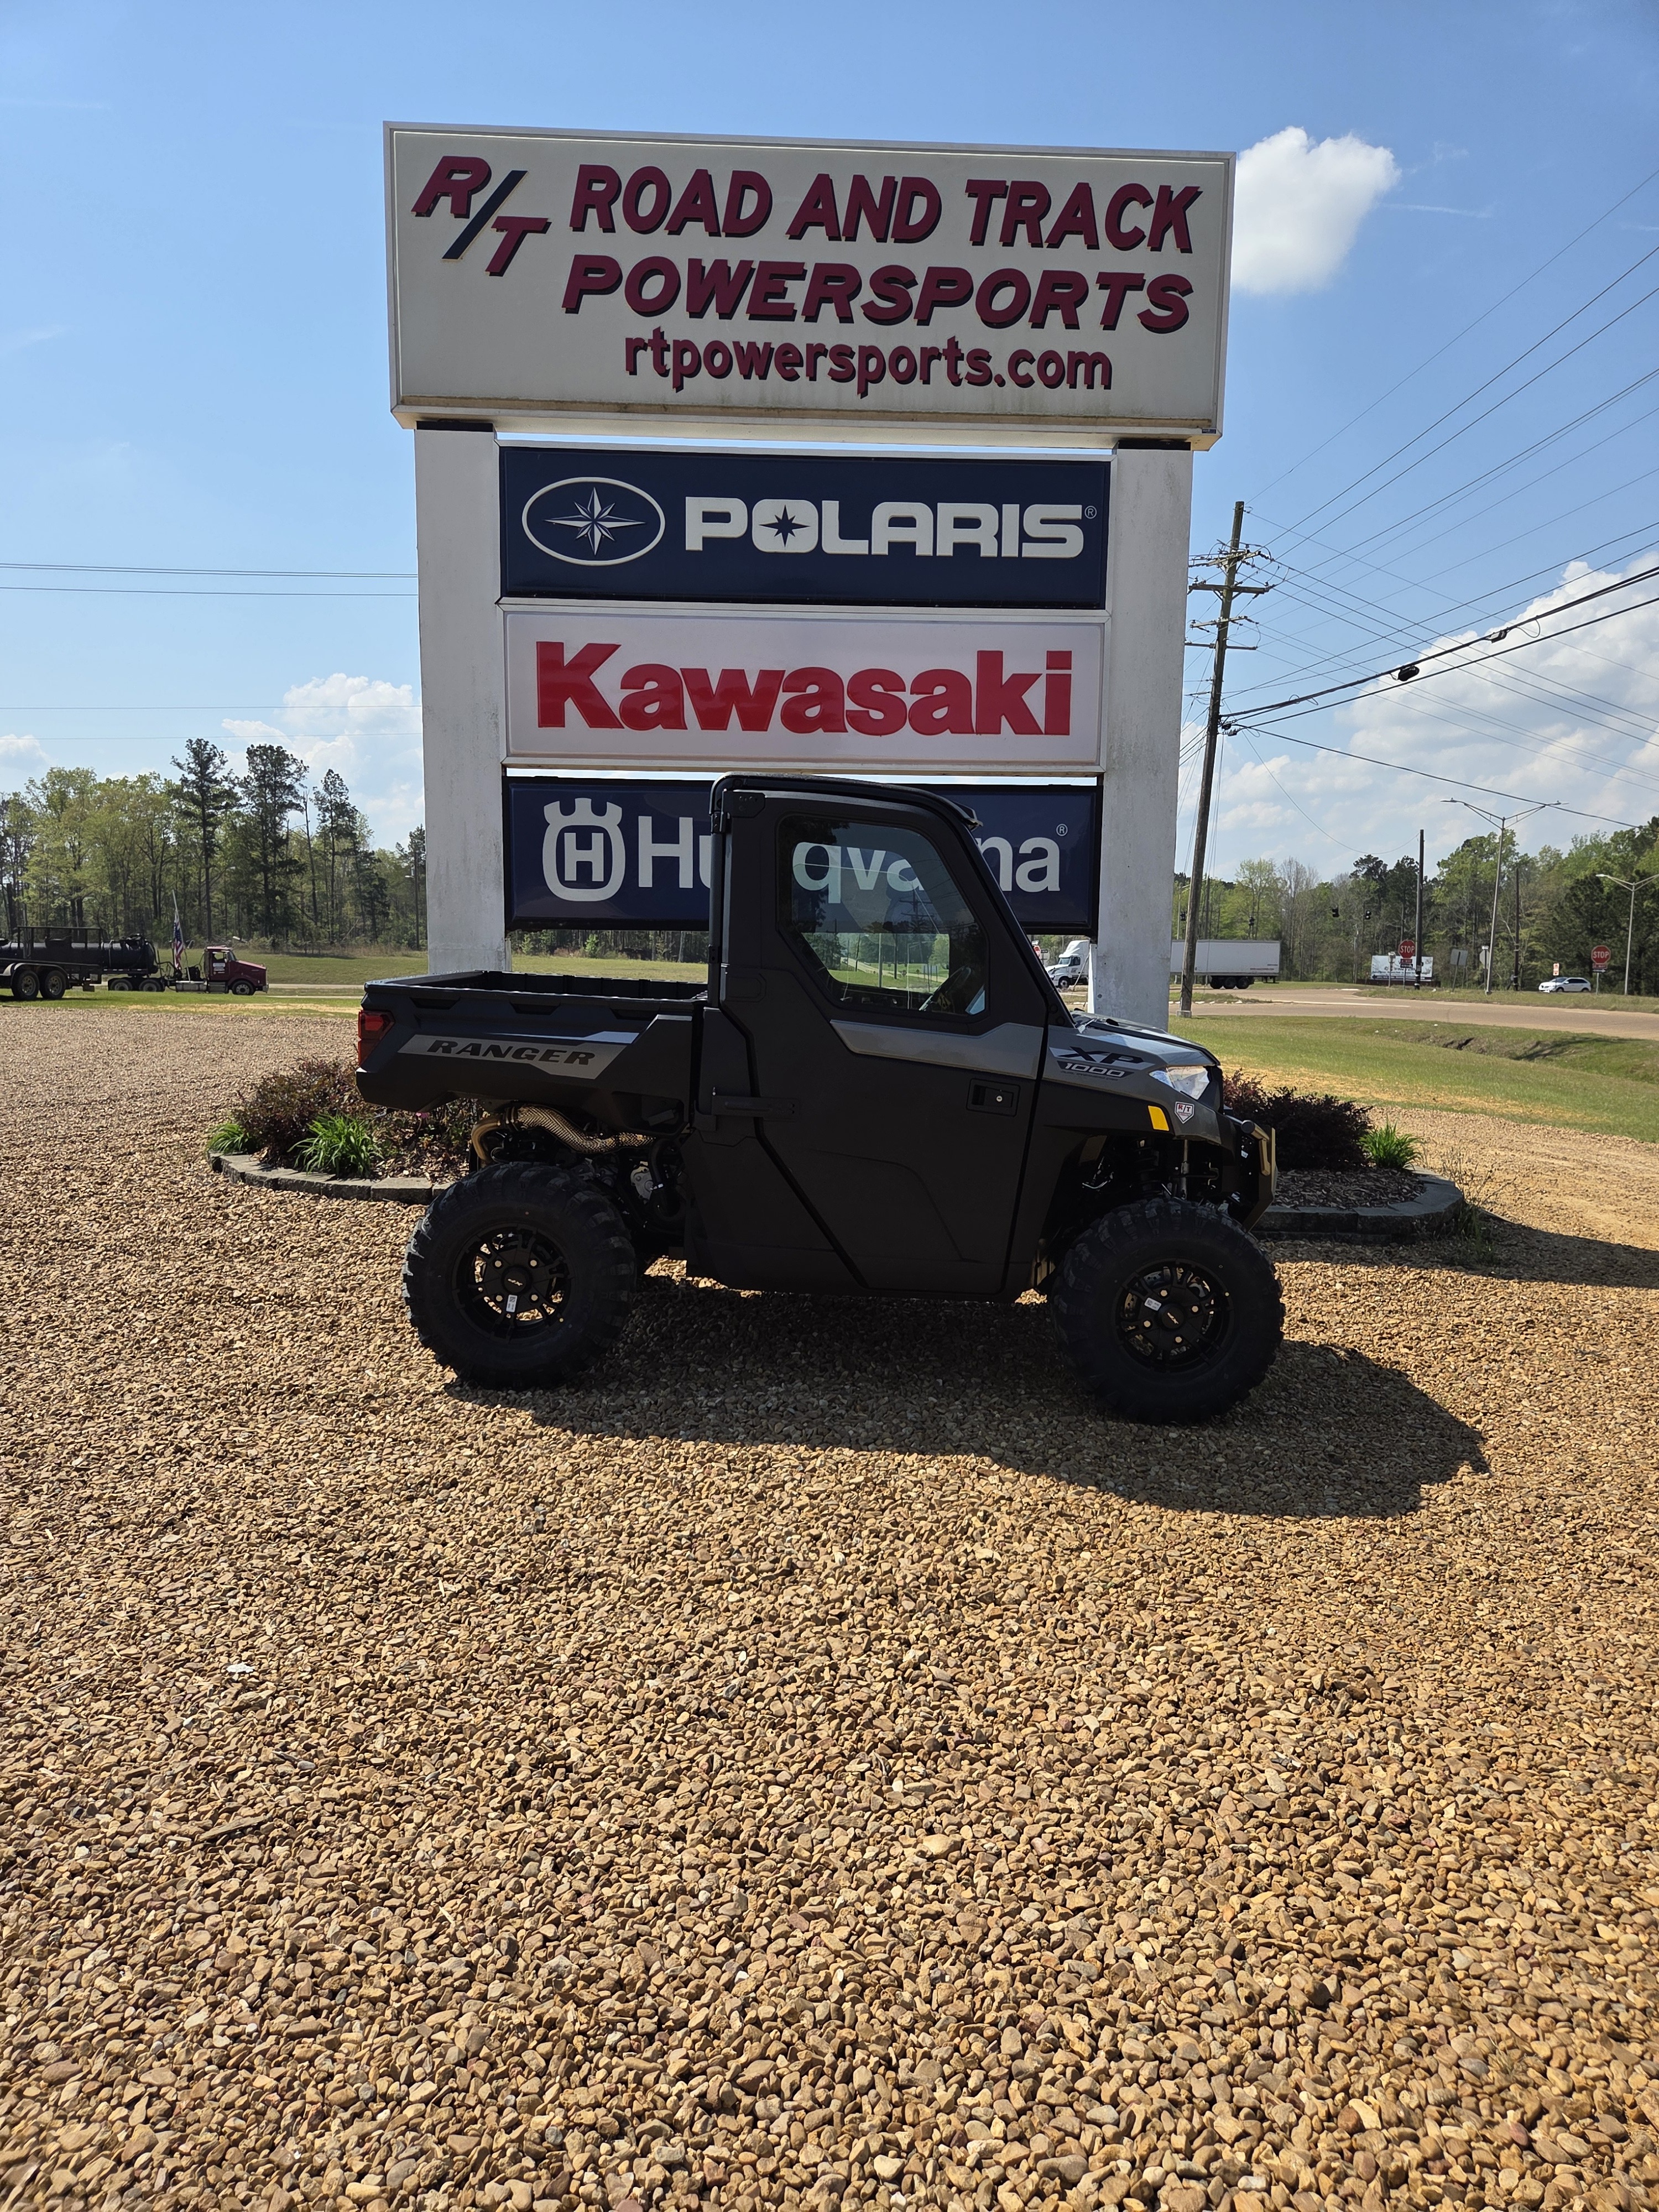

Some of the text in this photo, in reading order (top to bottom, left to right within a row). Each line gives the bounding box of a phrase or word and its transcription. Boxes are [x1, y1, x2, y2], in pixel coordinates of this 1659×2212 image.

[569, 164, 1203, 254] ROAD AND TRACK
[561, 254, 1194, 335] POWERSPORTS
[625, 326, 1113, 399] rtpowersports.com
[685, 495, 1084, 558] POLARIS
[536, 641, 1072, 737] Kawasaki
[426, 1039, 596, 1066] RANGER
[1057, 1046, 1145, 1065] XP
[1065, 1063, 1125, 1078] 1000
